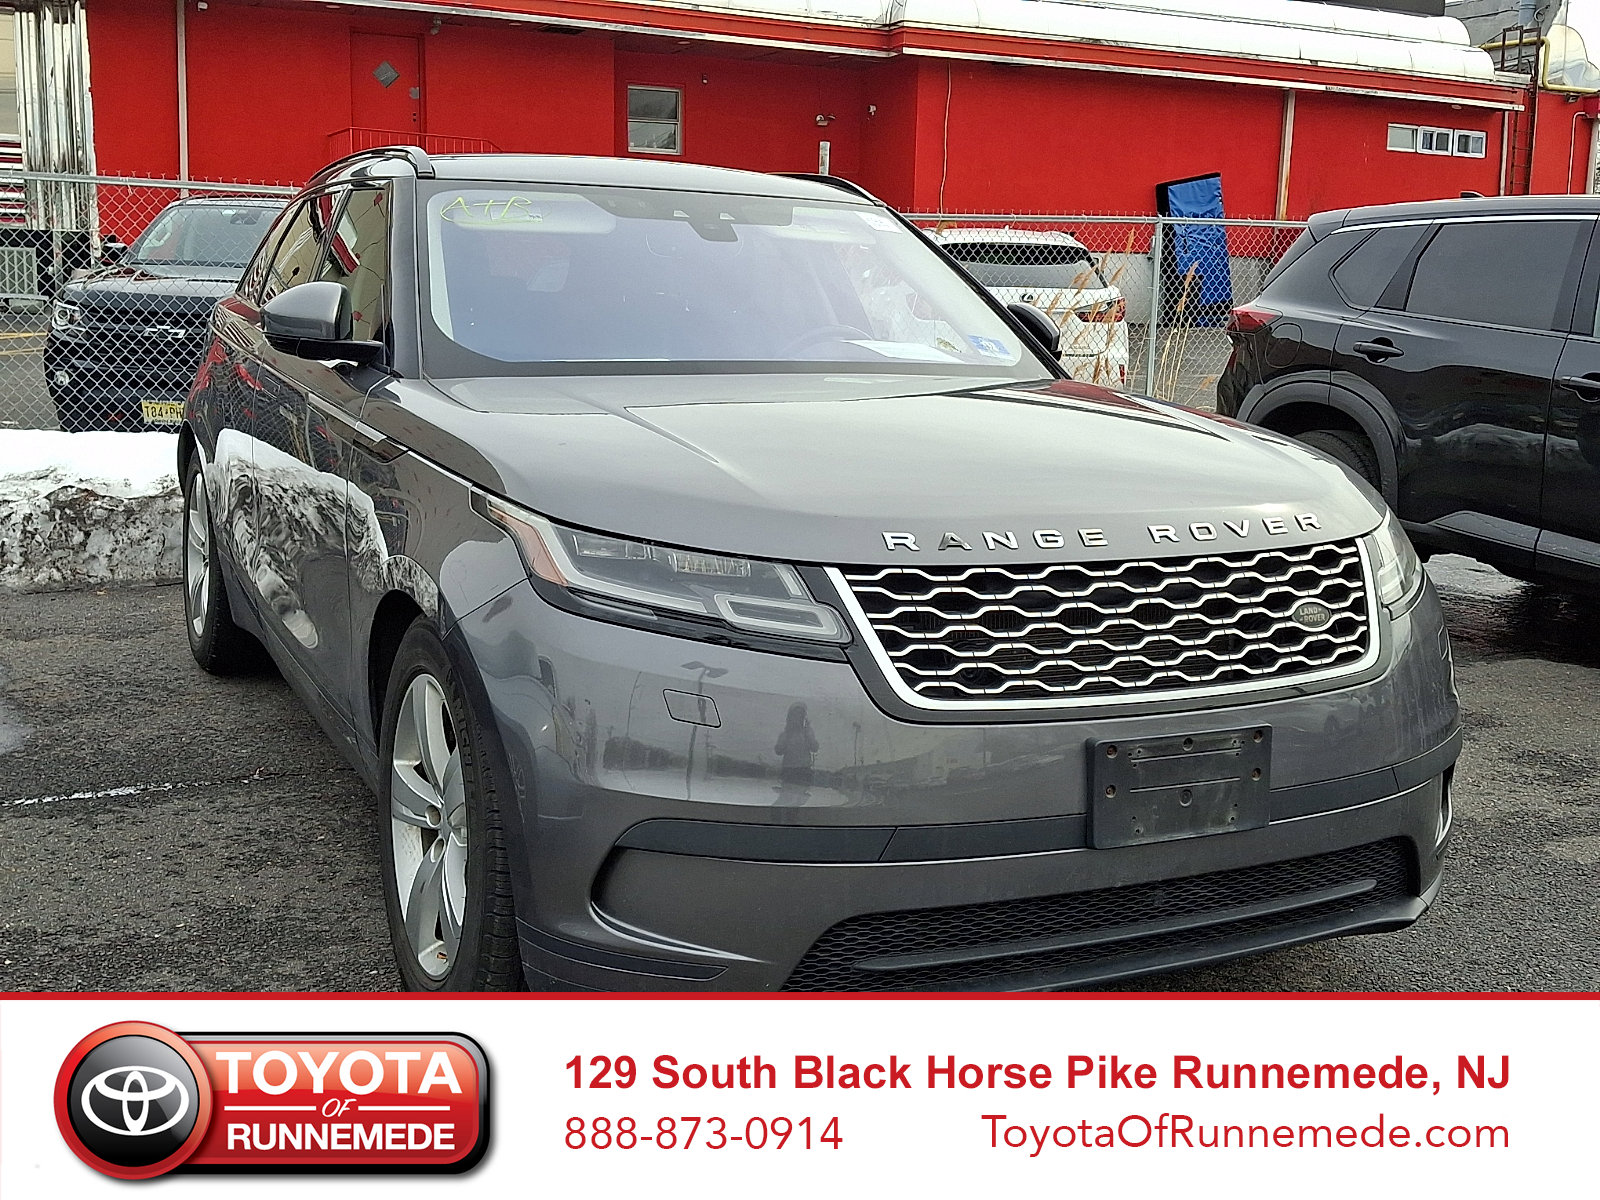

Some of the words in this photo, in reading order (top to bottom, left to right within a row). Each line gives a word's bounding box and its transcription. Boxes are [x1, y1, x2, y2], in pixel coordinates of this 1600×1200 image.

[882, 528, 1109, 551] RANGE
[1148, 511, 1323, 544] ROVER
[1300, 606, 1318, 616] LAND
[1303, 613, 1326, 623] ROVER
